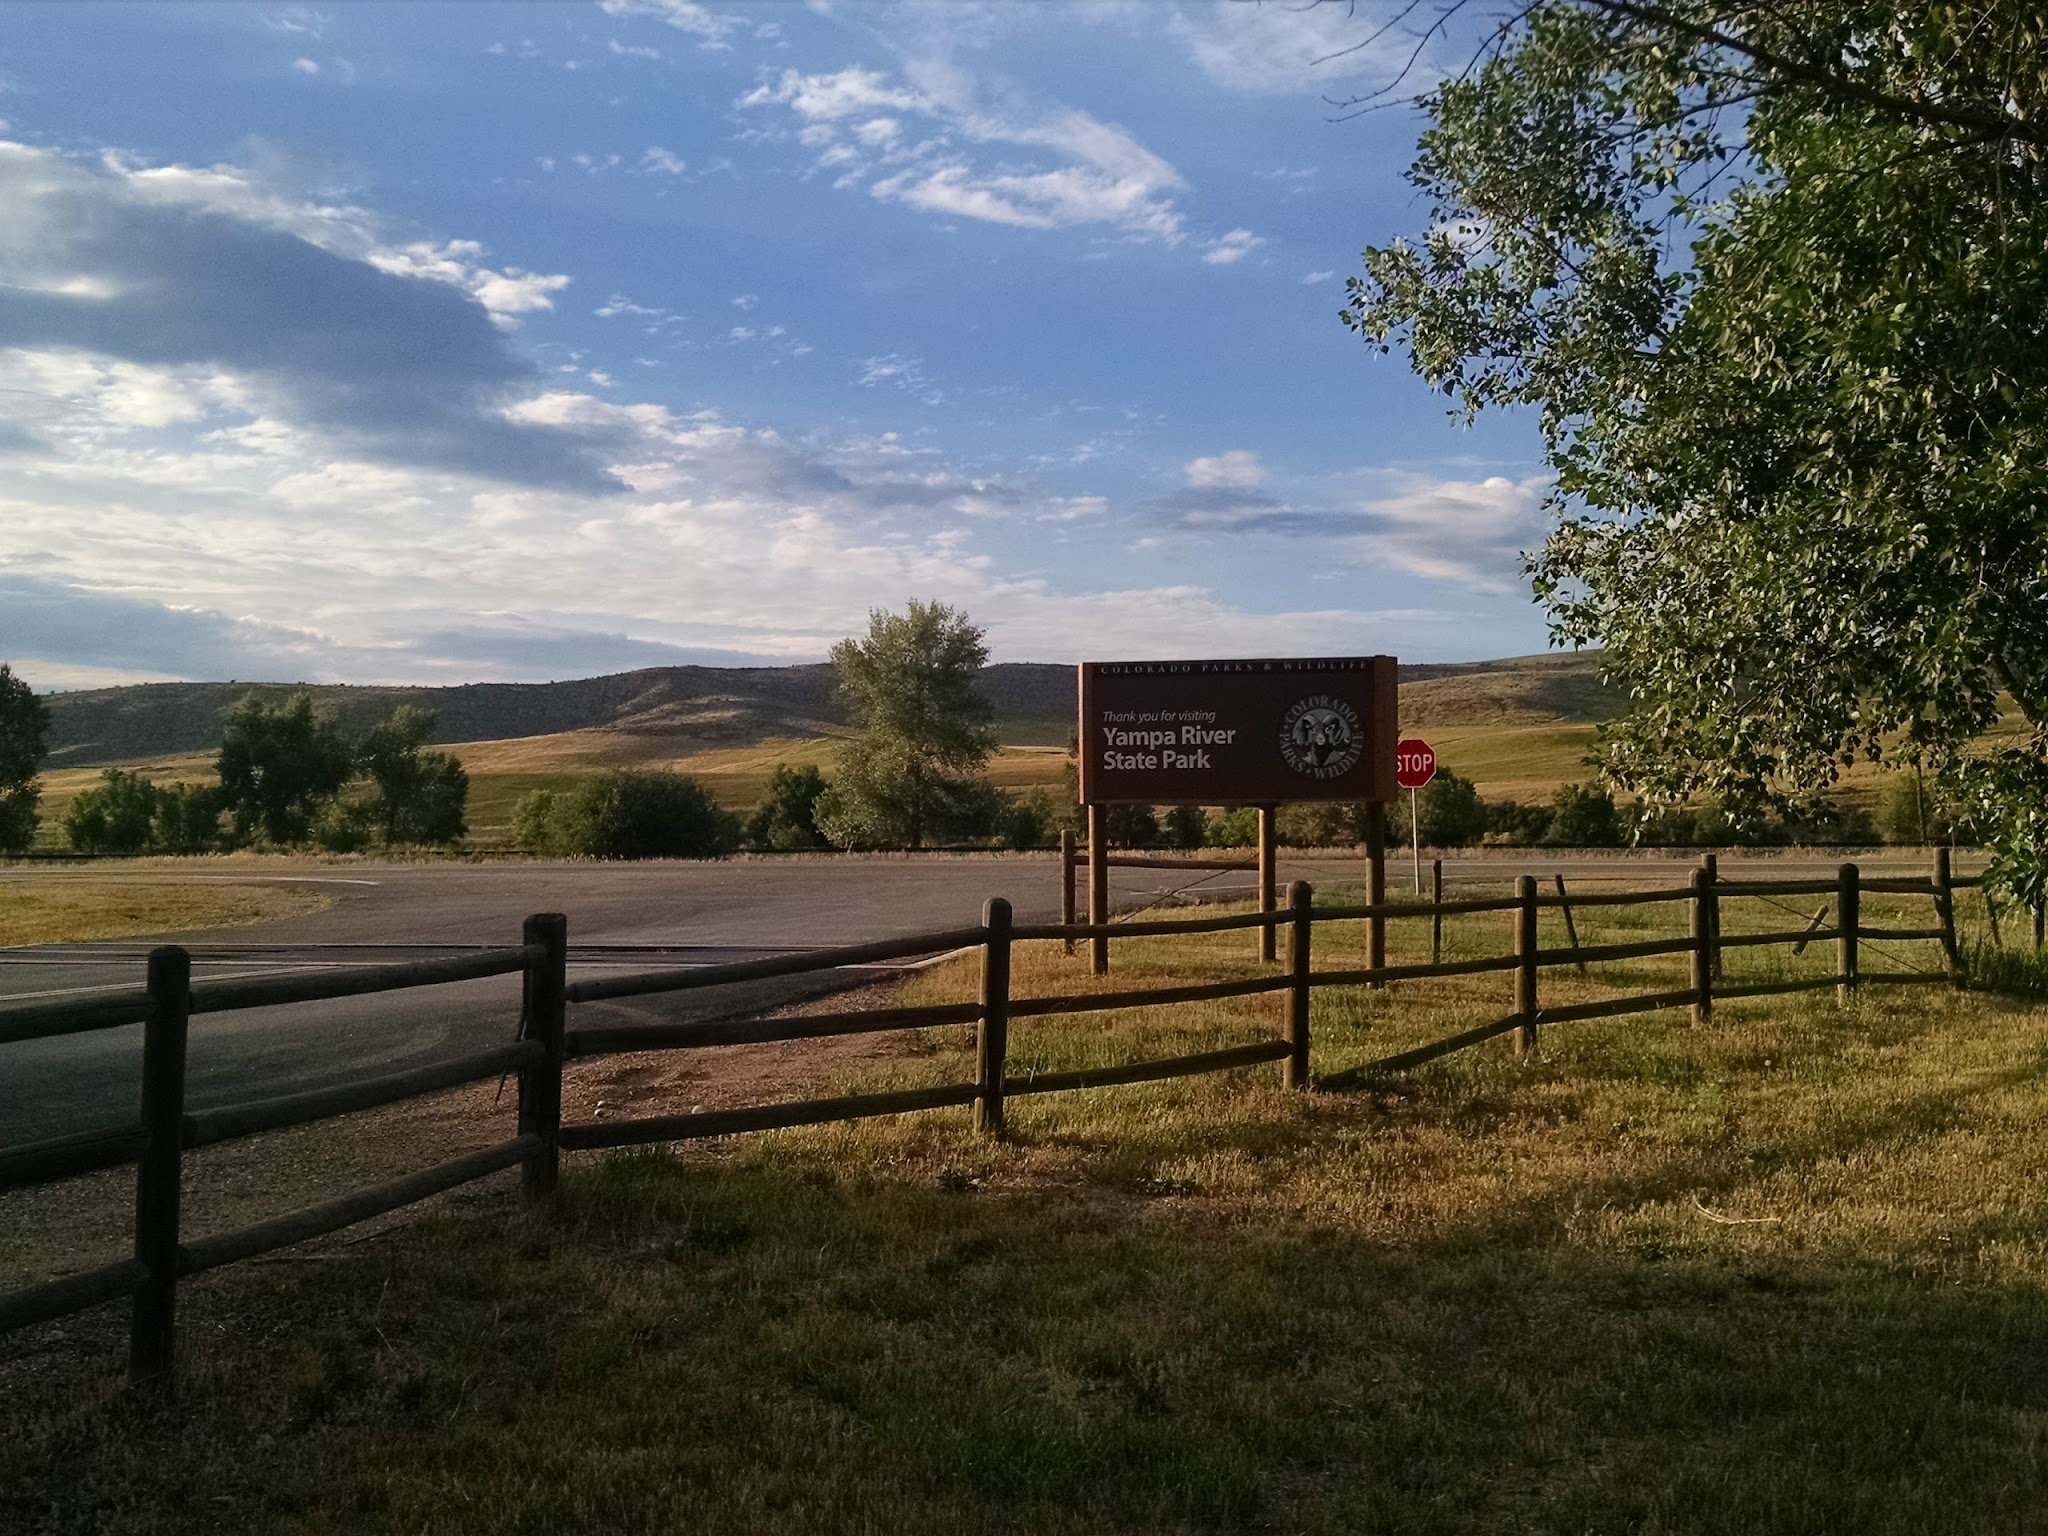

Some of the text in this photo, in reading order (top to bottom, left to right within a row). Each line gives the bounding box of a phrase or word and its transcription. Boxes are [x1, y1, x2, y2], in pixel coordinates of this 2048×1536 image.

[1101, 661, 1367, 675] COLORADO PARKS & WILDLIFE
[1103, 710, 1216, 724] Thank you for visiting
[1285, 695, 1358, 723] COLORADO
[1103, 725, 1236, 750] Yampa River
[1103, 749, 1211, 769] State Park
[1280, 731, 1365, 779] PARKS WILDLIFE
